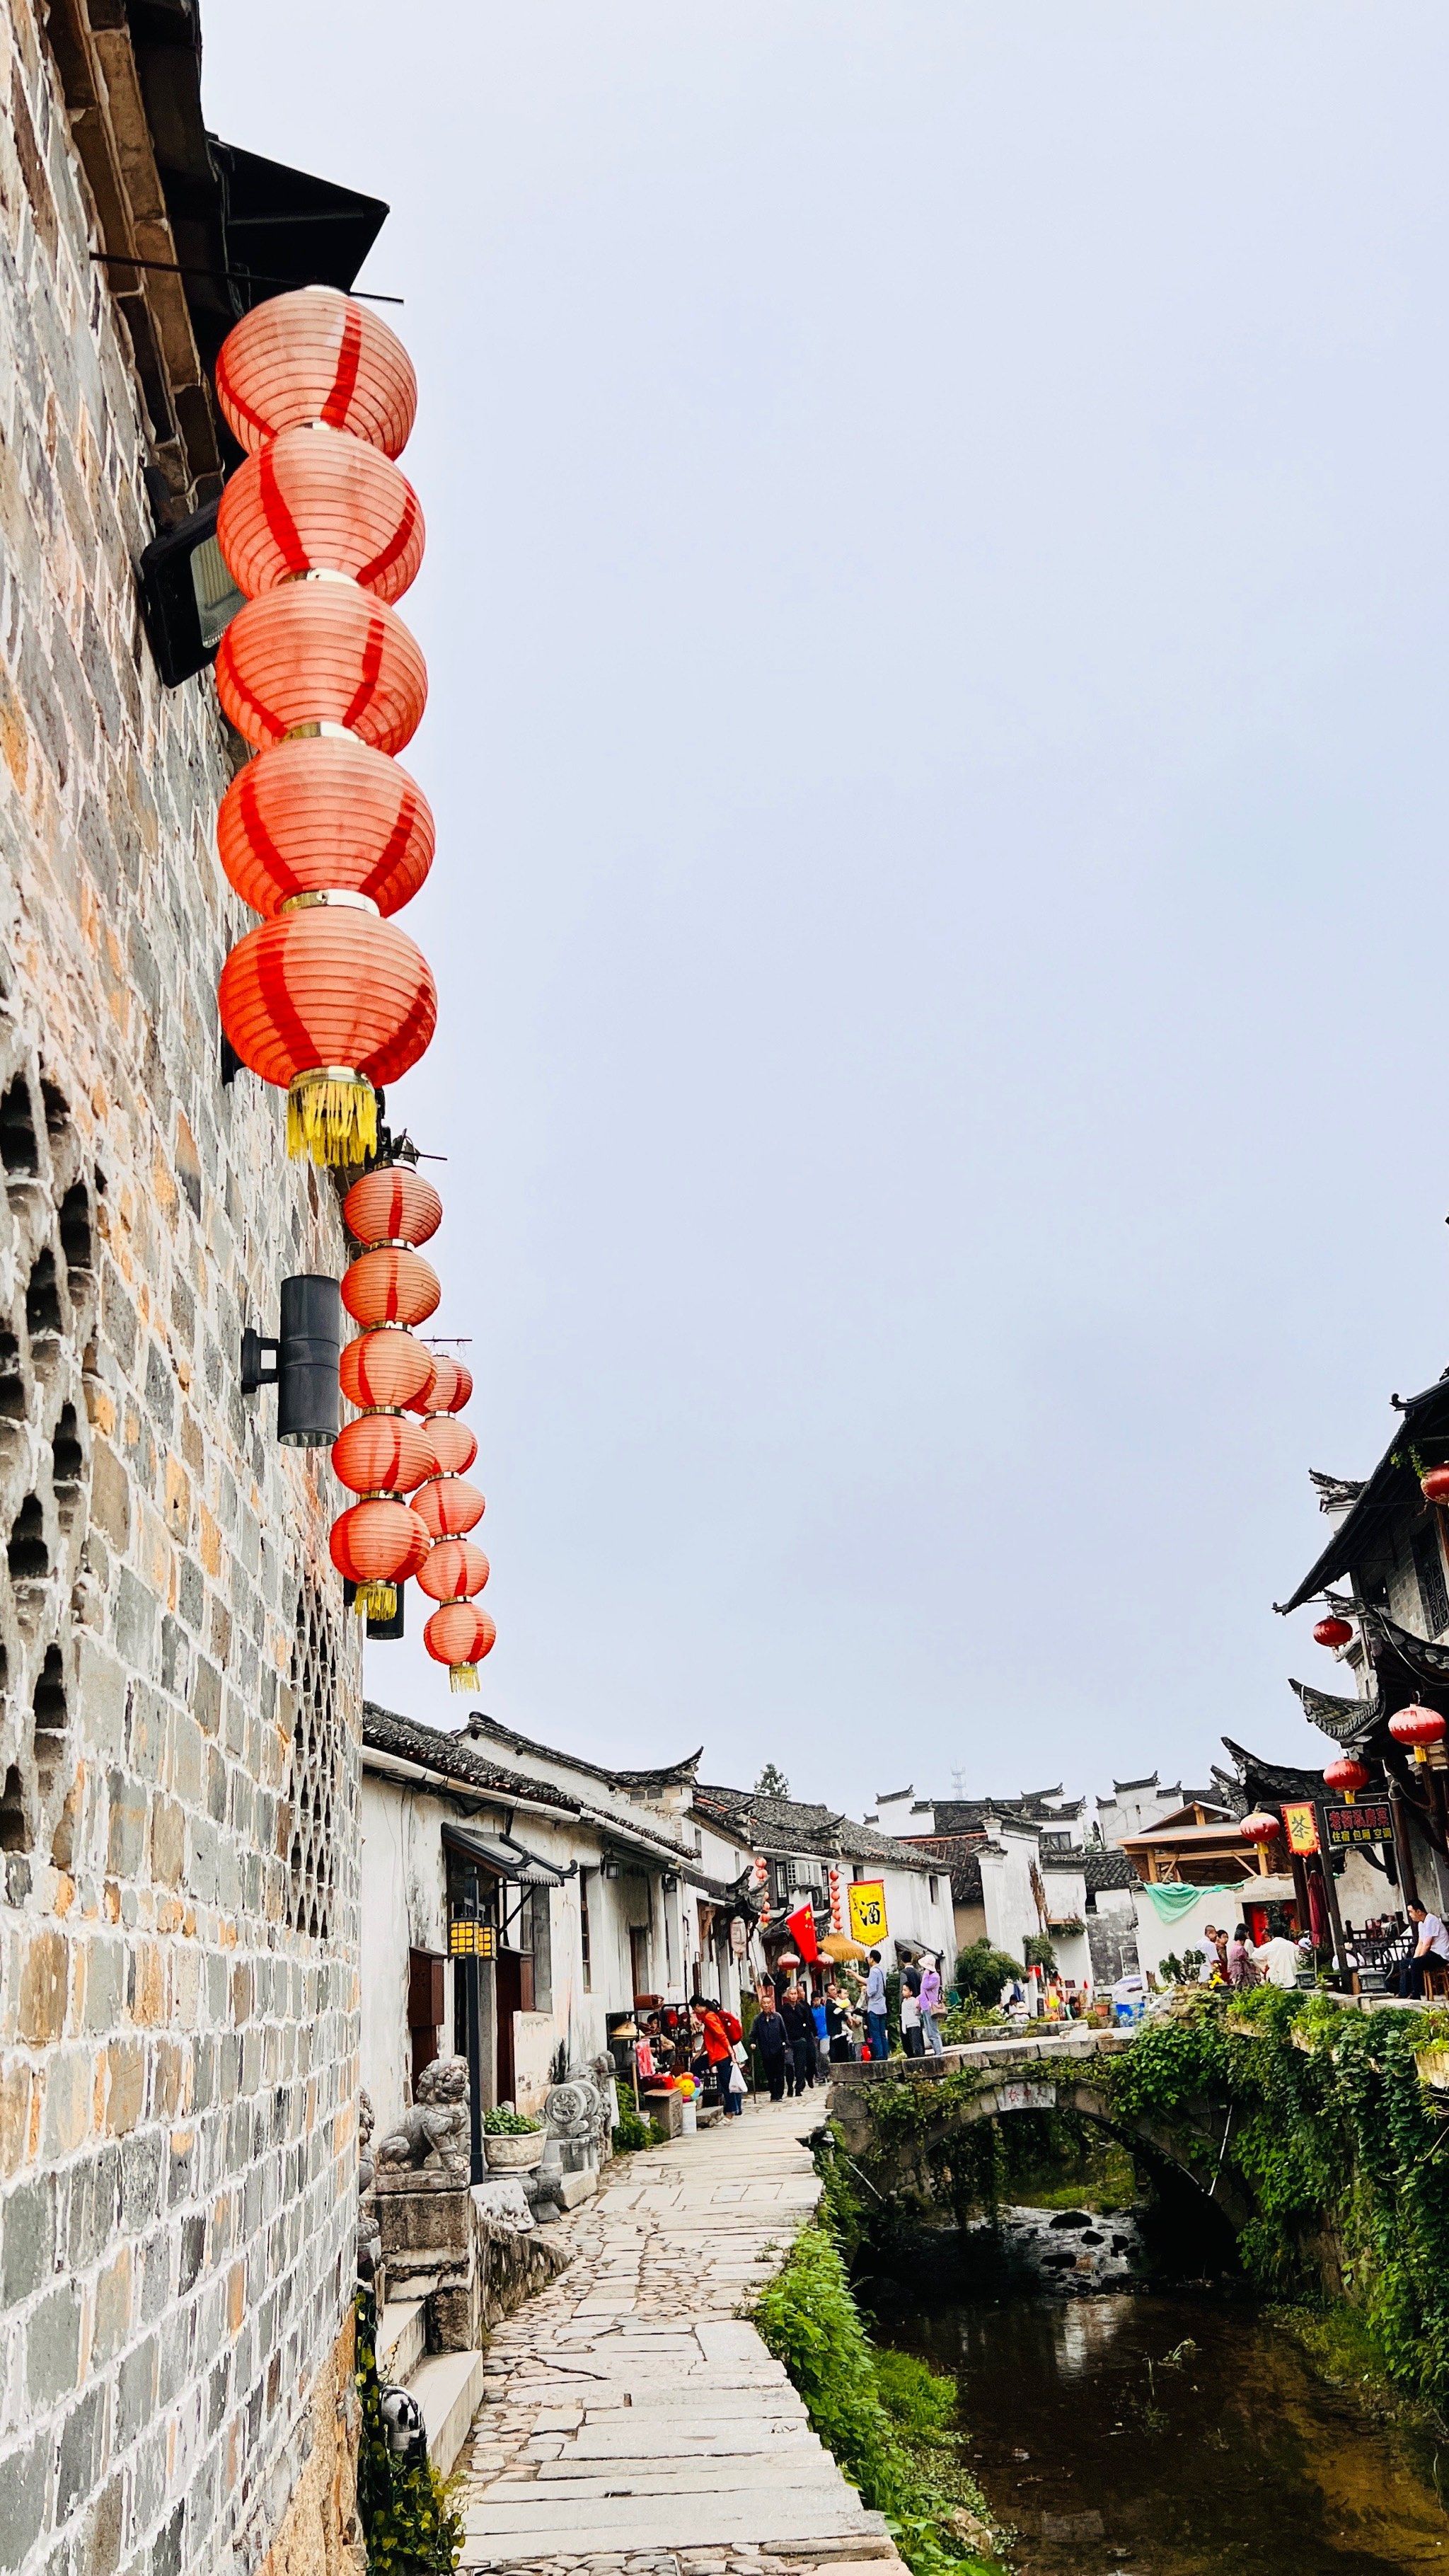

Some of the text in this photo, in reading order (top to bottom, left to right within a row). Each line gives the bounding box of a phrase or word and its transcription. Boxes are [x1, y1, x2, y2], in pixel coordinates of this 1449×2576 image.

[1291, 1815, 1311, 1839] 茶
[1329, 1807, 1389, 1830] 老街私房菜
[1332, 1830, 1350, 1842] 住宿
[1373, 1827, 1392, 1839] 空调
[859, 1901, 880, 1926] 酒
